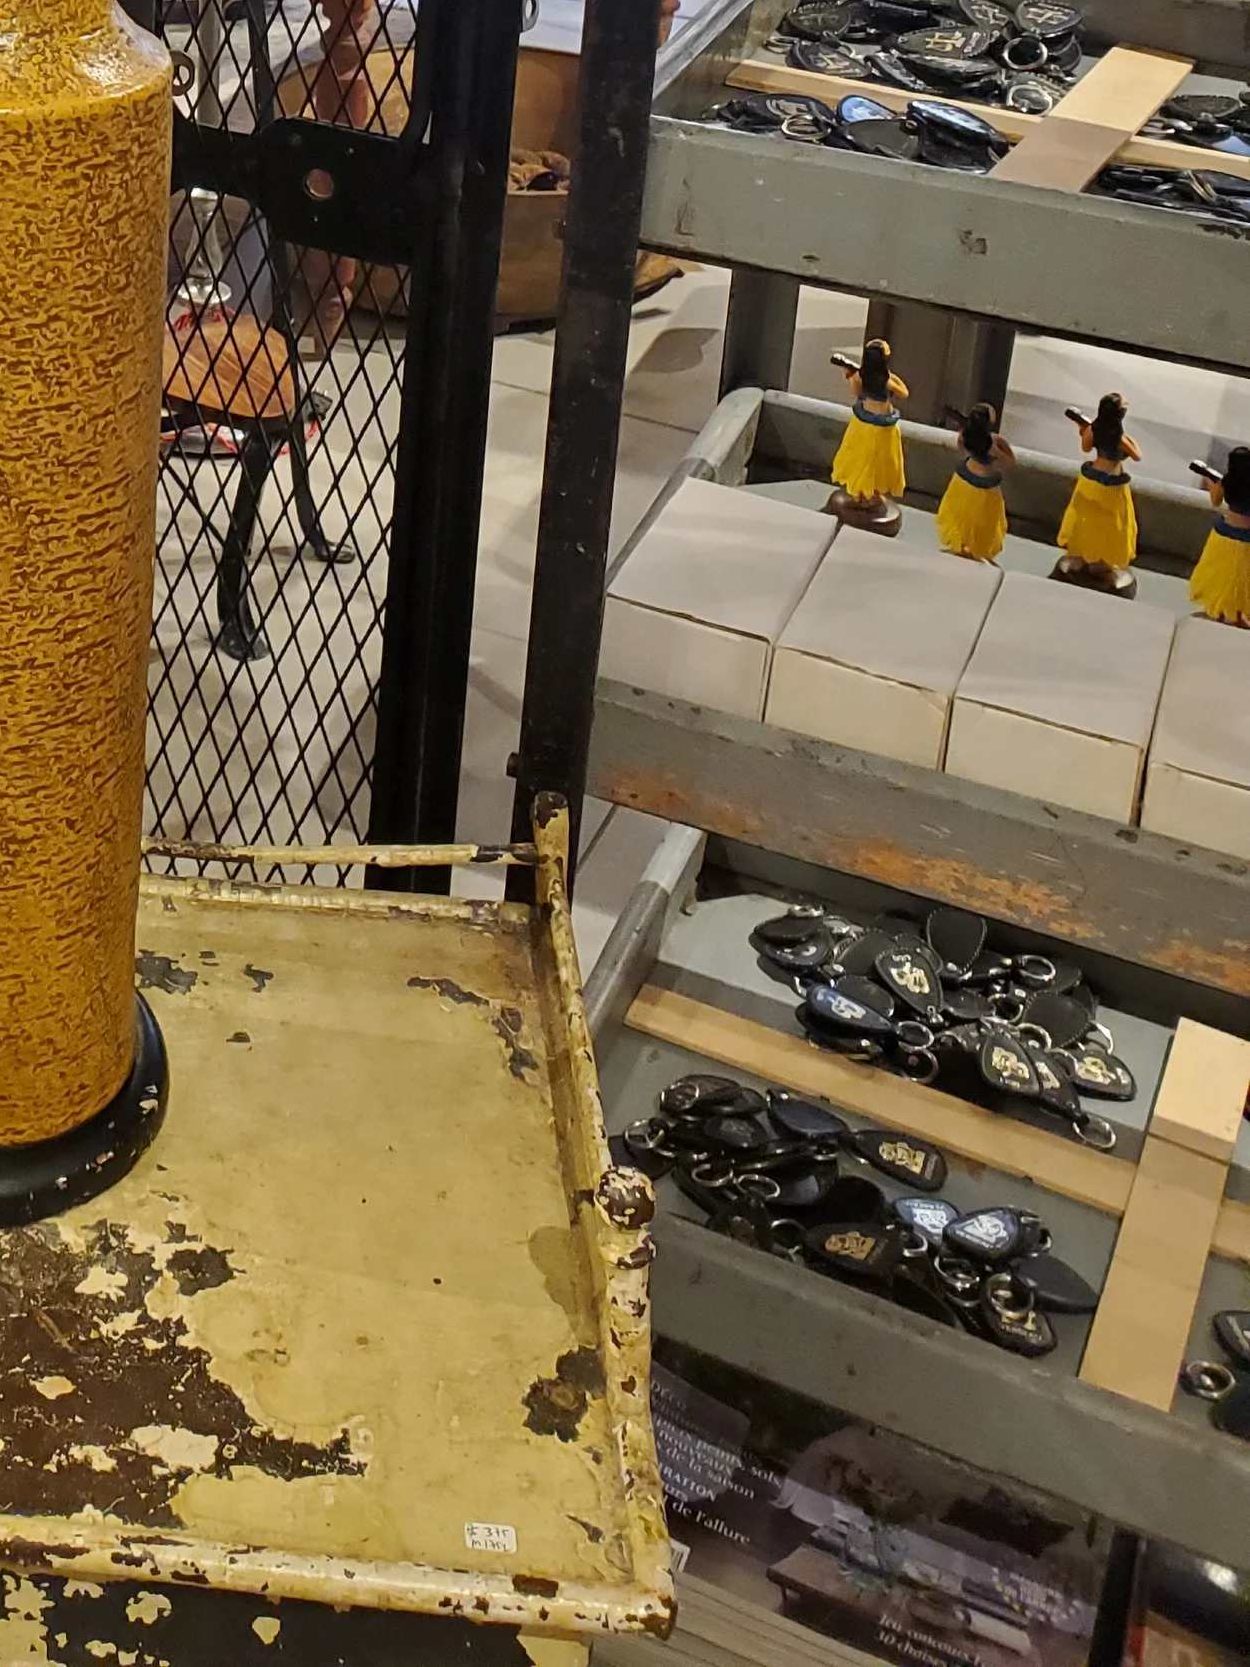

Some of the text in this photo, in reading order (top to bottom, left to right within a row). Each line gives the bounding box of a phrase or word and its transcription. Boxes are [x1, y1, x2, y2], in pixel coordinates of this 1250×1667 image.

[708, 1471, 755, 1500] saison
[672, 1498, 750, 1544] de l'allure
